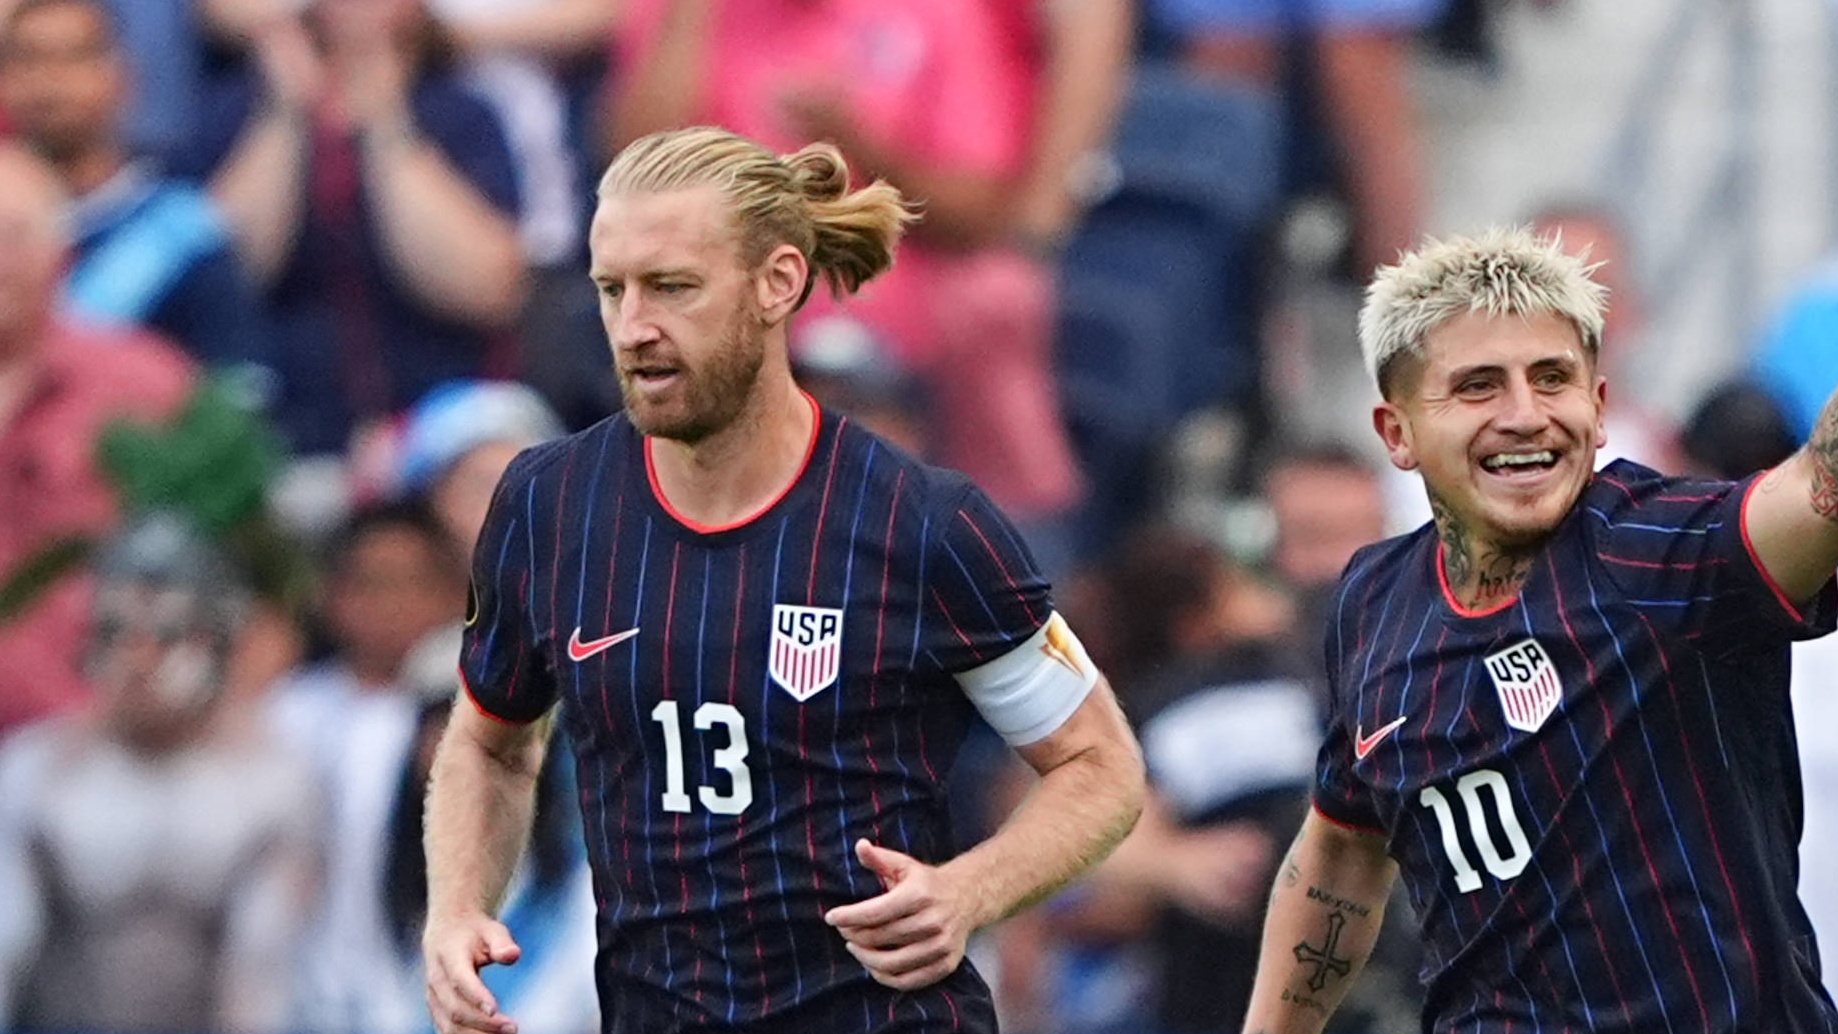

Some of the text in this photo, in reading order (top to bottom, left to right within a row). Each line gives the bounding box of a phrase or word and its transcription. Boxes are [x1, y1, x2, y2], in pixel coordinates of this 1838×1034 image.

[778, 610, 838, 647] USA
[1490, 642, 1545, 683] USA
[650, 699, 754, 816] 13
[1419, 769, 1534, 894] 10
